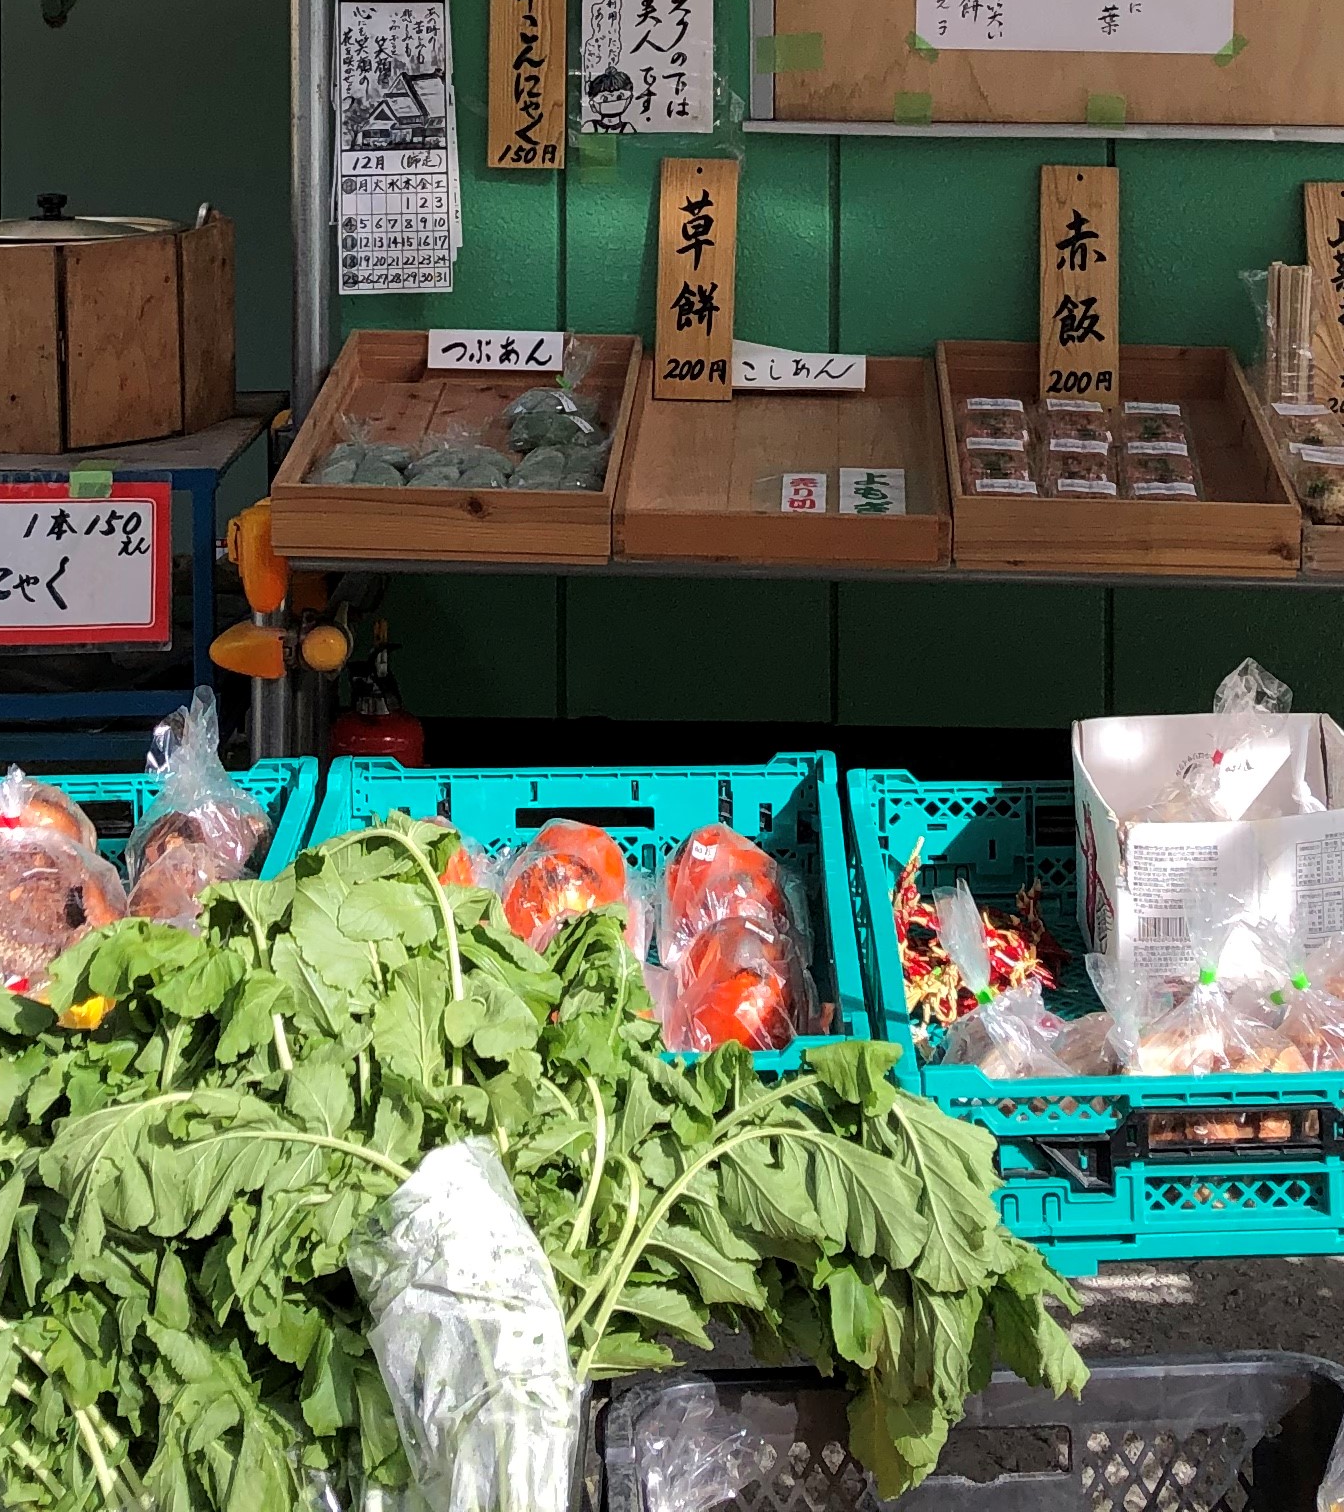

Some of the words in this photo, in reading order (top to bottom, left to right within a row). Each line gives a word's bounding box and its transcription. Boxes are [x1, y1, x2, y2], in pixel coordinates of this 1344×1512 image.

[352, 155, 385, 171] 12月
[498, 143, 557, 165] 150円
[406, 196, 410, 210] 1
[419, 197, 428, 208] 2
[435, 196, 444, 208] 3
[345, 218, 355, 231] 4
[359, 218, 370, 229] 5
[374, 217, 383, 229] 6
[387, 218, 398, 229] 7
[404, 219, 413, 229] 8
[419, 217, 427, 229] 9
[434, 217, 446, 228] 10
[359, 236, 370, 249] 12
[374, 236, 384, 248] 13
[387, 236, 402, 248] 14
[402, 236, 415, 248] 15
[418, 235, 431, 247] 16
[434, 235, 448, 248] 17
[359, 255, 370, 268] 19
[373, 255, 386, 267] 20
[387, 255, 400, 267] 21
[402, 255, 416, 266] 22
[418, 255, 432, 266] 23
[434, 254, 449, 265] 24
[669, 190, 720, 338] 草餅
[358, 273, 373, 285] 26
[373, 273, 388, 285] 27
[388, 273, 402, 284] 28
[403, 272, 417, 285] 29
[419, 272, 433, 283] 30
[435, 271, 447, 283] 31
[1053, 208, 1108, 347] 赤飯
[441, 336, 553, 368] つぶあん
[662, 357, 727, 384] 200円
[740, 354, 859, 383] こしあん
[1047, 370, 1114, 395] 200円
